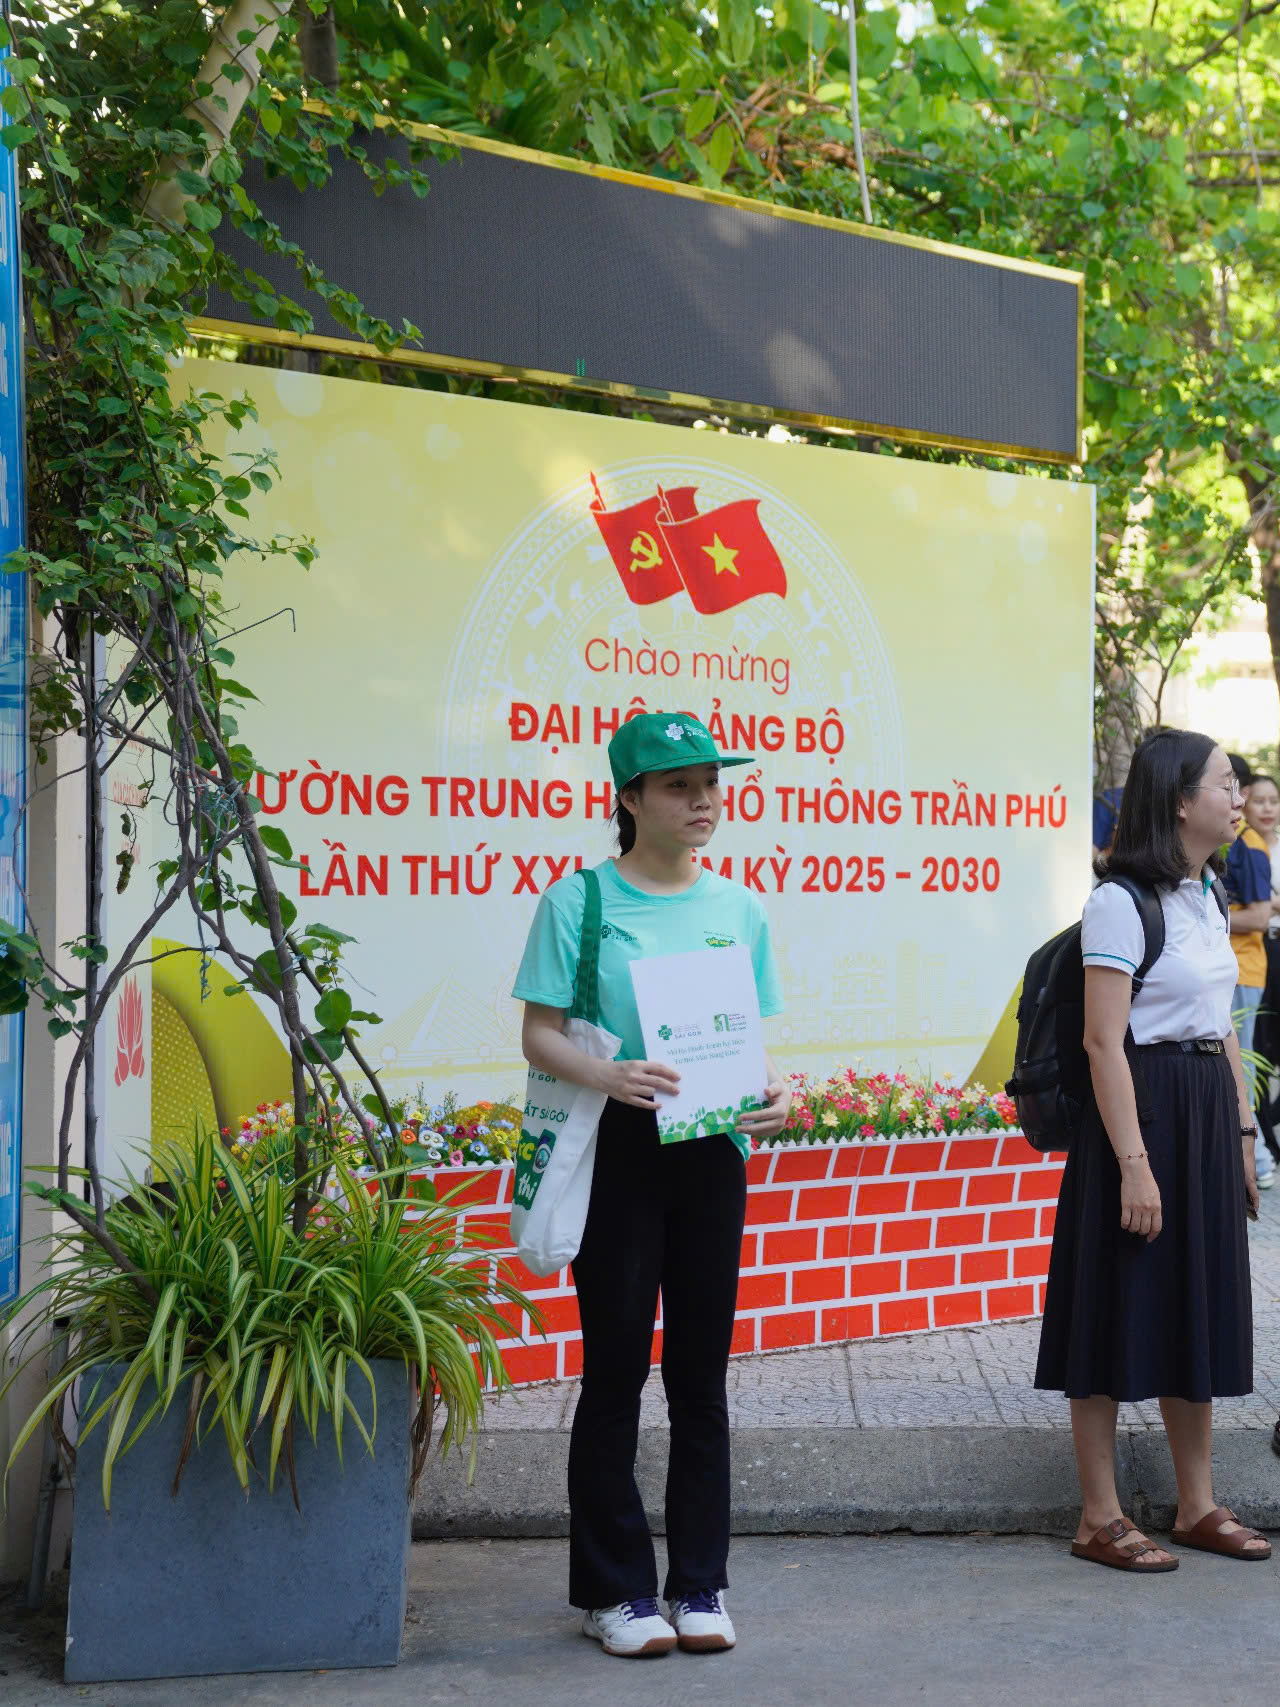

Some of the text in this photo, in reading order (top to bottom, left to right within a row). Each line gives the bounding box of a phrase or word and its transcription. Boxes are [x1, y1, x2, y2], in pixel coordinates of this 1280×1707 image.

[584, 638, 790, 696] Chào mừng
[509, 702, 580, 754] ĐẠI
[680, 698, 785, 752] ẢNG
[796, 708, 844, 764] BỘ
[186, 759, 409, 816] ƯỜNG
[421, 776, 573, 819] TRUNG
[722, 769, 764, 822] HỔ
[775, 777, 901, 824] THÔNG
[910, 779, 996, 827] TRẦN
[1005, 784, 1066, 828] PHÚ
[299, 838, 388, 896] LẦN
[402, 843, 501, 895] THỨ
[744, 844, 792, 893] KỲ
[802, 856, 885, 893] 2025
[922, 857, 1000, 893] 2030
